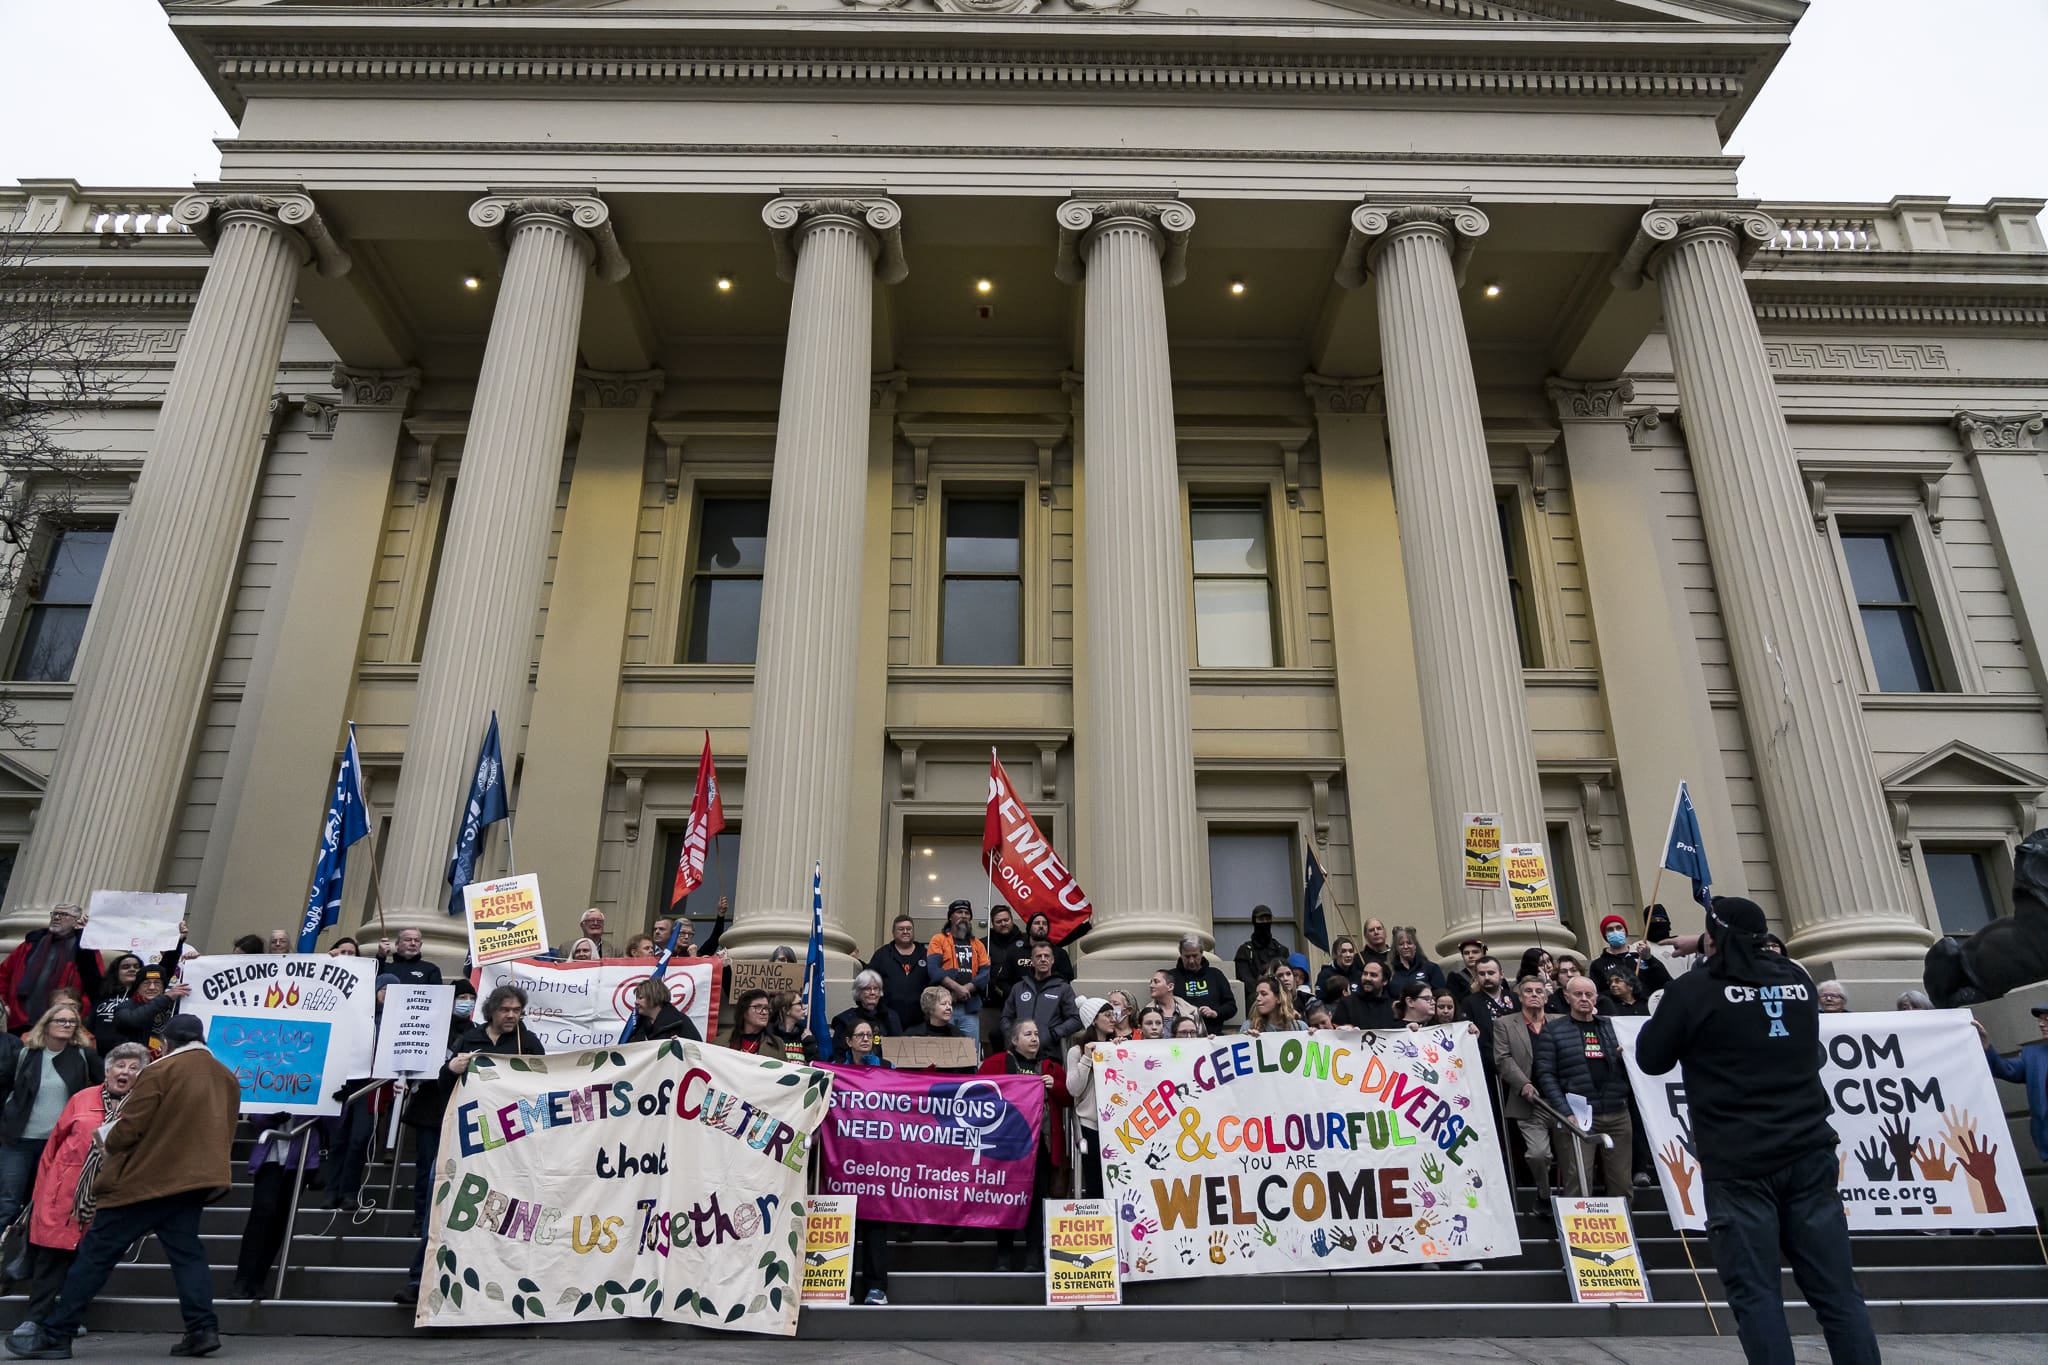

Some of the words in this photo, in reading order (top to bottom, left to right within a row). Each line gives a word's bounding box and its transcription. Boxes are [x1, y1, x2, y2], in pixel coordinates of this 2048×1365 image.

[1470, 828, 1495, 838] FIGHT
[1466, 838, 1500, 848] RACISM
[1510, 858, 1538, 868] FIGHT
[1473, 871, 1500, 879] STRENGTH
[1507, 868, 1546, 878] RACISM
[481, 891, 524, 908] FIGHT
[1515, 895, 1549, 903] SOLIDARITY
[1522, 900, 1552, 909] STRENGTH
[474, 900, 533, 920] RACISM
[478, 944, 488, 952] IS
[490, 934, 538, 950] STRENGTH
[480, 928, 534, 945] SOLIDARITY
[202, 962, 279, 1001] GEELONG
[285, 961, 317, 978] ONE
[319, 963, 359, 1000] FIRE
[495, 974, 589, 996] Combined
[734, 976, 757, 988] HAS
[761, 978, 793, 990] NEVER
[1724, 984, 1808, 1003] CFMEU
[556, 1028, 614, 1047] Group
[244, 1050, 297, 1068] says
[1114, 1079, 1178, 1154] KEEP
[1193, 1038, 1353, 1091] GEELONG
[1359, 1054, 1480, 1166] DIVERSE
[1833, 1076, 1945, 1115] CISM
[829, 1091, 911, 1113] STRONG
[918, 1095, 996, 1119] UNIONS
[456, 1079, 634, 1158] ELEMENTS
[637, 1078, 676, 1116] of
[676, 1067, 808, 1174] CULTURE
[836, 1118, 894, 1140] NEED
[900, 1124, 980, 1147] WOMEN
[1175, 1106, 1217, 1162] &
[1216, 1110, 1417, 1153] COLOURFUL
[596, 1142, 669, 1179] that
[1238, 1155, 1273, 1174] YOU
[1285, 1154, 1318, 1169] ARE
[842, 1159, 911, 1183] Geelong
[916, 1163, 970, 1182] Trades
[975, 1168, 1006, 1185] Hall
[891, 1182, 959, 1201] Unionist
[963, 1185, 1028, 1206] Network
[1150, 1167, 1413, 1231] WELCOME
[1839, 1186, 1937, 1205] ance.org
[446, 1173, 562, 1246] BRING
[636, 1191, 780, 1259] Together
[806, 1217, 842, 1229] IGHT
[1573, 1217, 1617, 1230] FIGHT
[1059, 1219, 1105, 1232] FIGHT
[808, 1231, 849, 1243] CISM
[1051, 1233, 1113, 1246] RACISM
[1568, 1231, 1629, 1244] RACISM
[805, 1269, 844, 1277] IDARITY
[1054, 1271, 1112, 1280] SOLIDARITY
[1579, 1269, 1634, 1277] SOLIDARITY
[802, 1278, 846, 1287] TRENGTH
[1052, 1281, 1061, 1289] IS
[1064, 1280, 1115, 1289] STRENGTH
[1579, 1278, 1589, 1287] IS
[1591, 1278, 1640, 1287] STRENGTH
